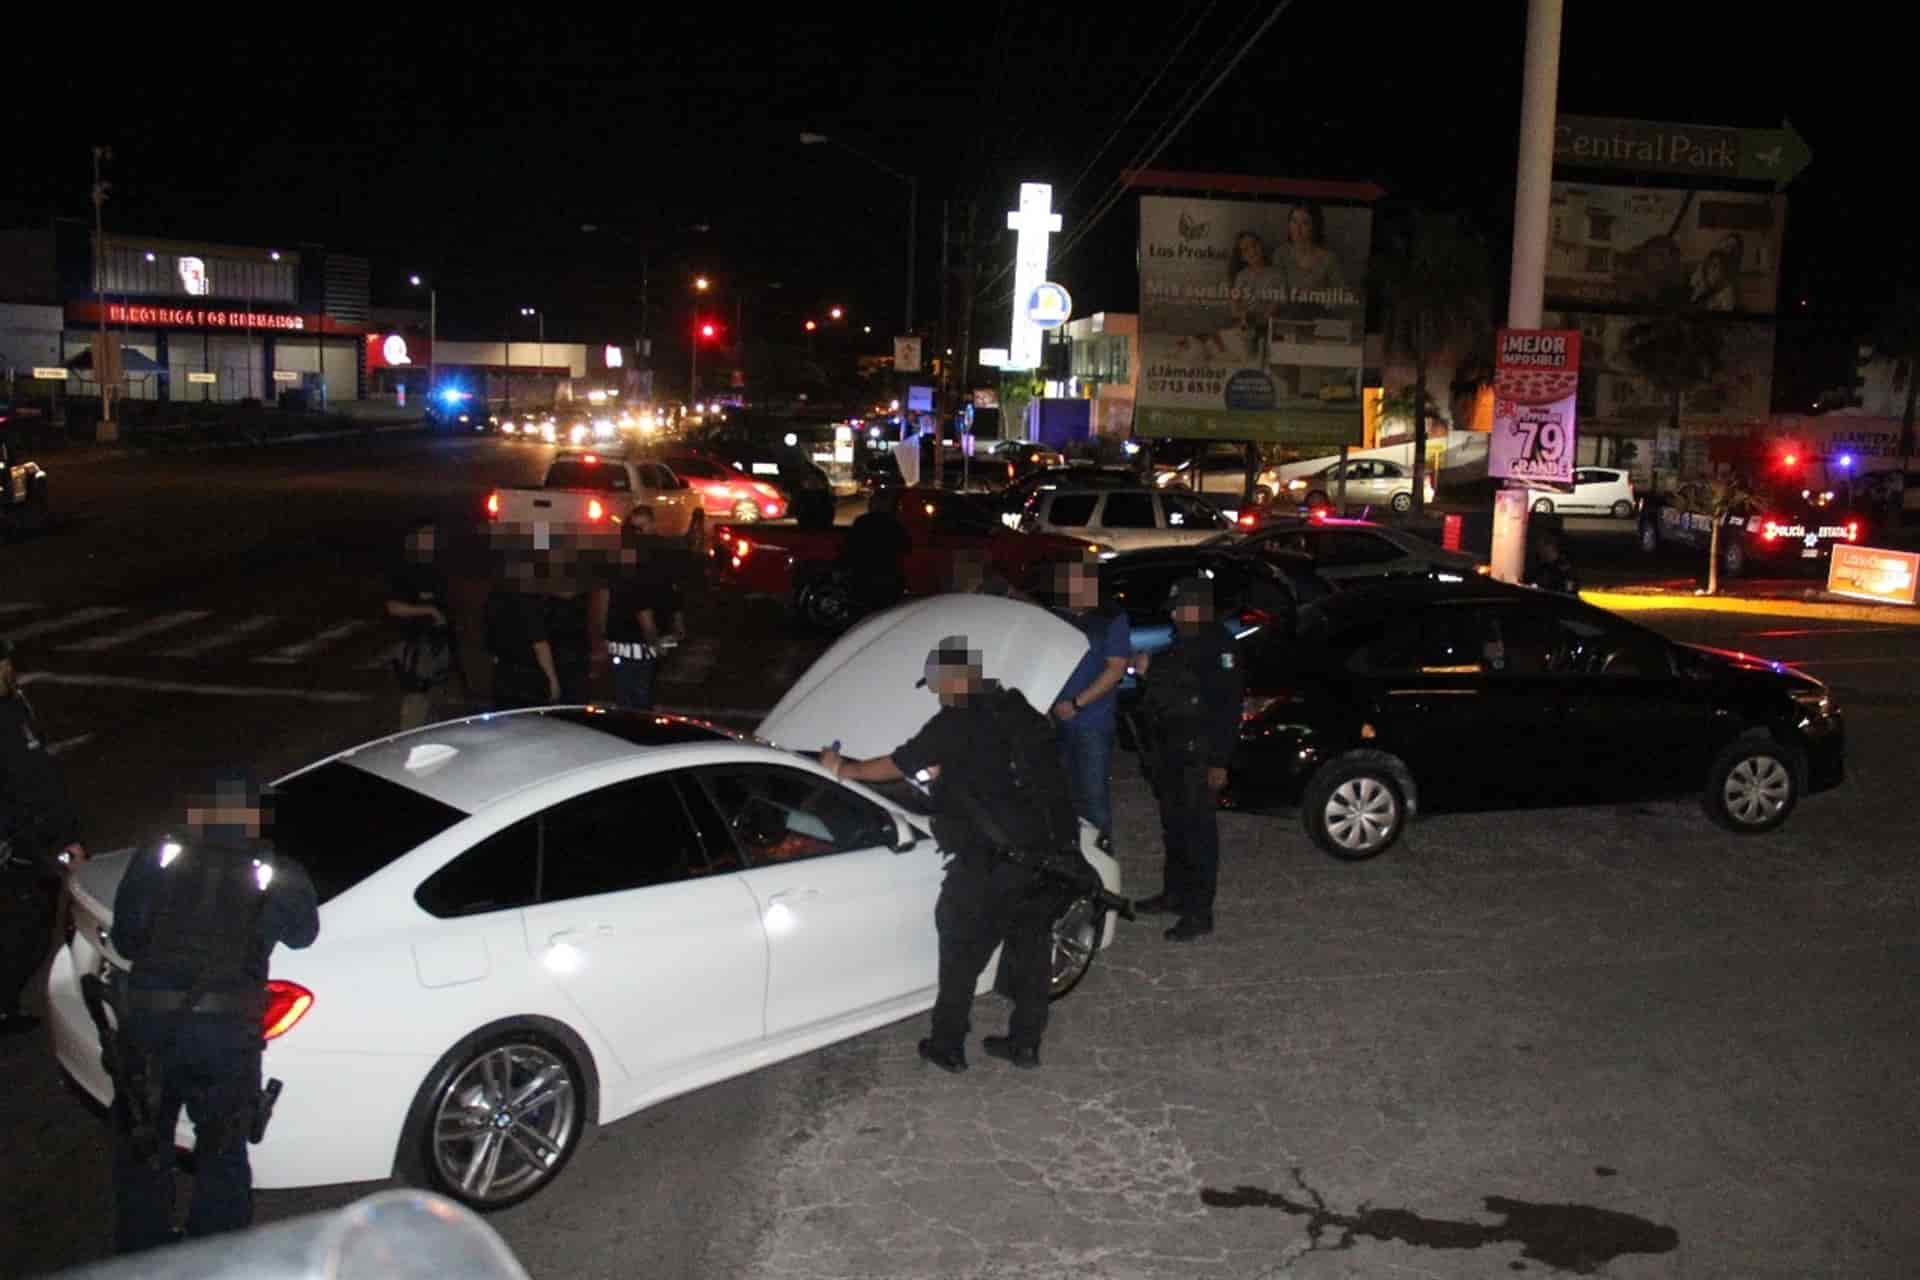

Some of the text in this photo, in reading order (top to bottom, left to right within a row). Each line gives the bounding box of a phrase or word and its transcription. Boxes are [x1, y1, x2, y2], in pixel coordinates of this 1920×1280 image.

[1670, 134, 1735, 169] Park
[1503, 335, 1566, 355] ¡MEJOR
[1507, 457, 1569, 478] GRANDE
